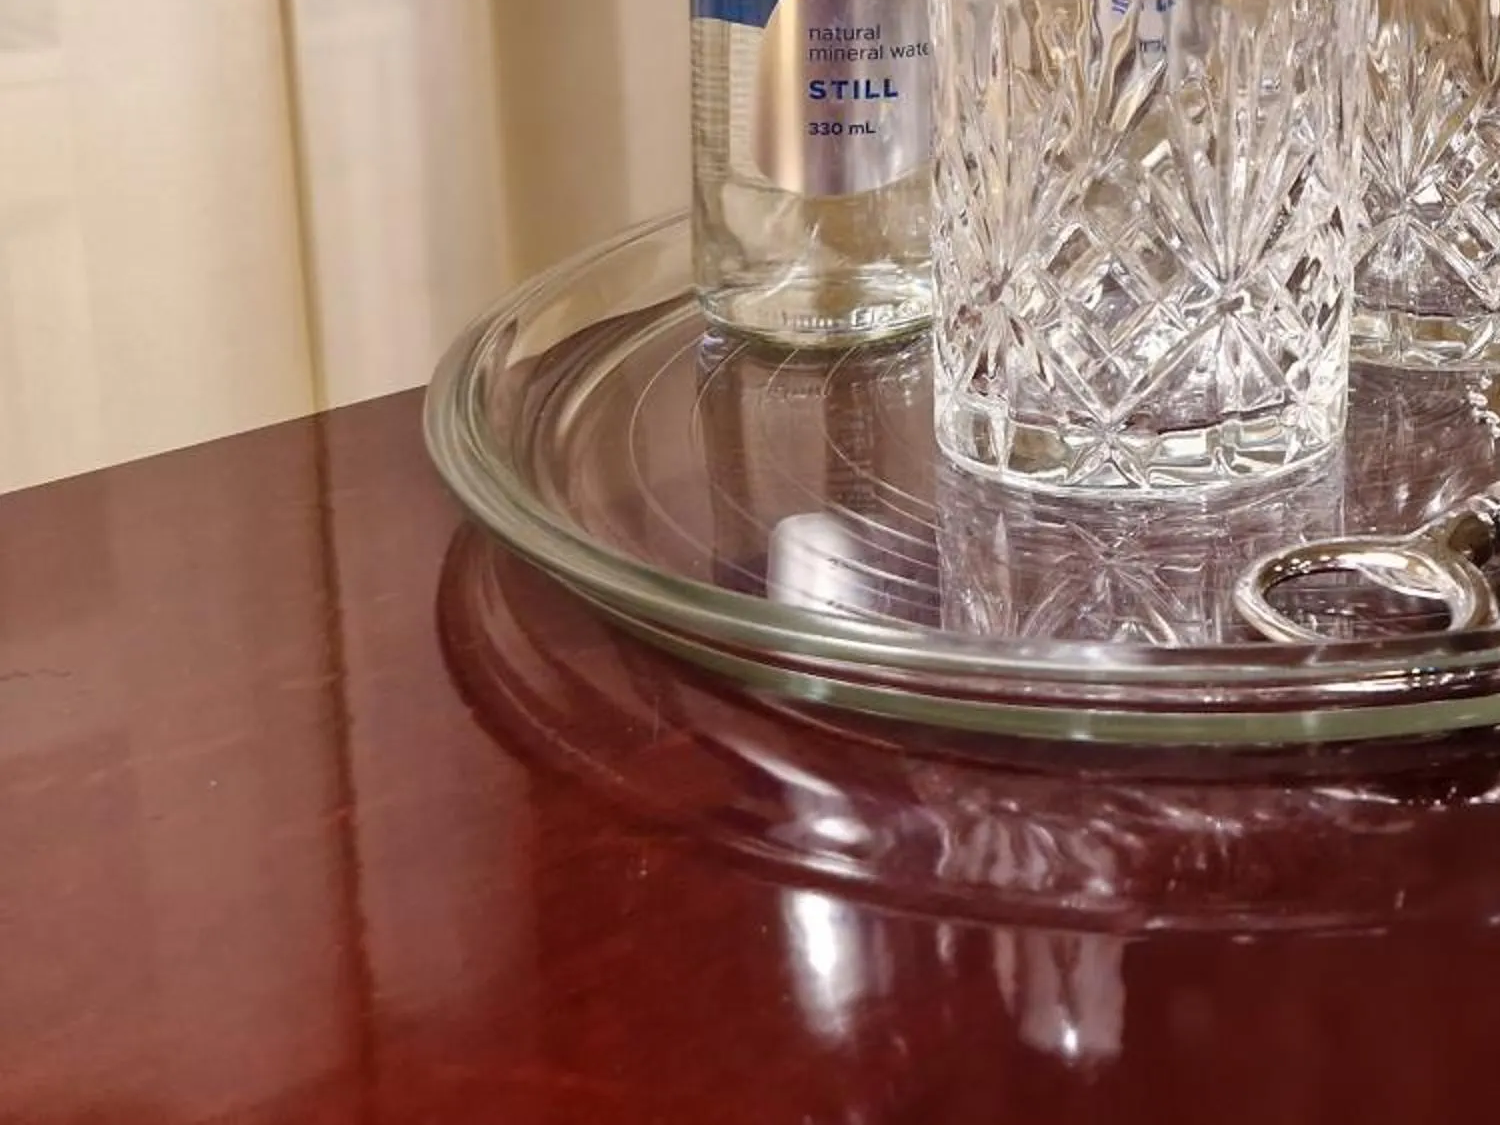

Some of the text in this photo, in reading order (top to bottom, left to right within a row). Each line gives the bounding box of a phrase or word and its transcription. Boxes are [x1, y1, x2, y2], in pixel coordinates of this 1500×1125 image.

[809, 24, 881, 42] natural
[809, 42, 930, 62] mineral wate
[809, 78, 899, 100] STILL
[808, 120, 877, 136] 330 mL
